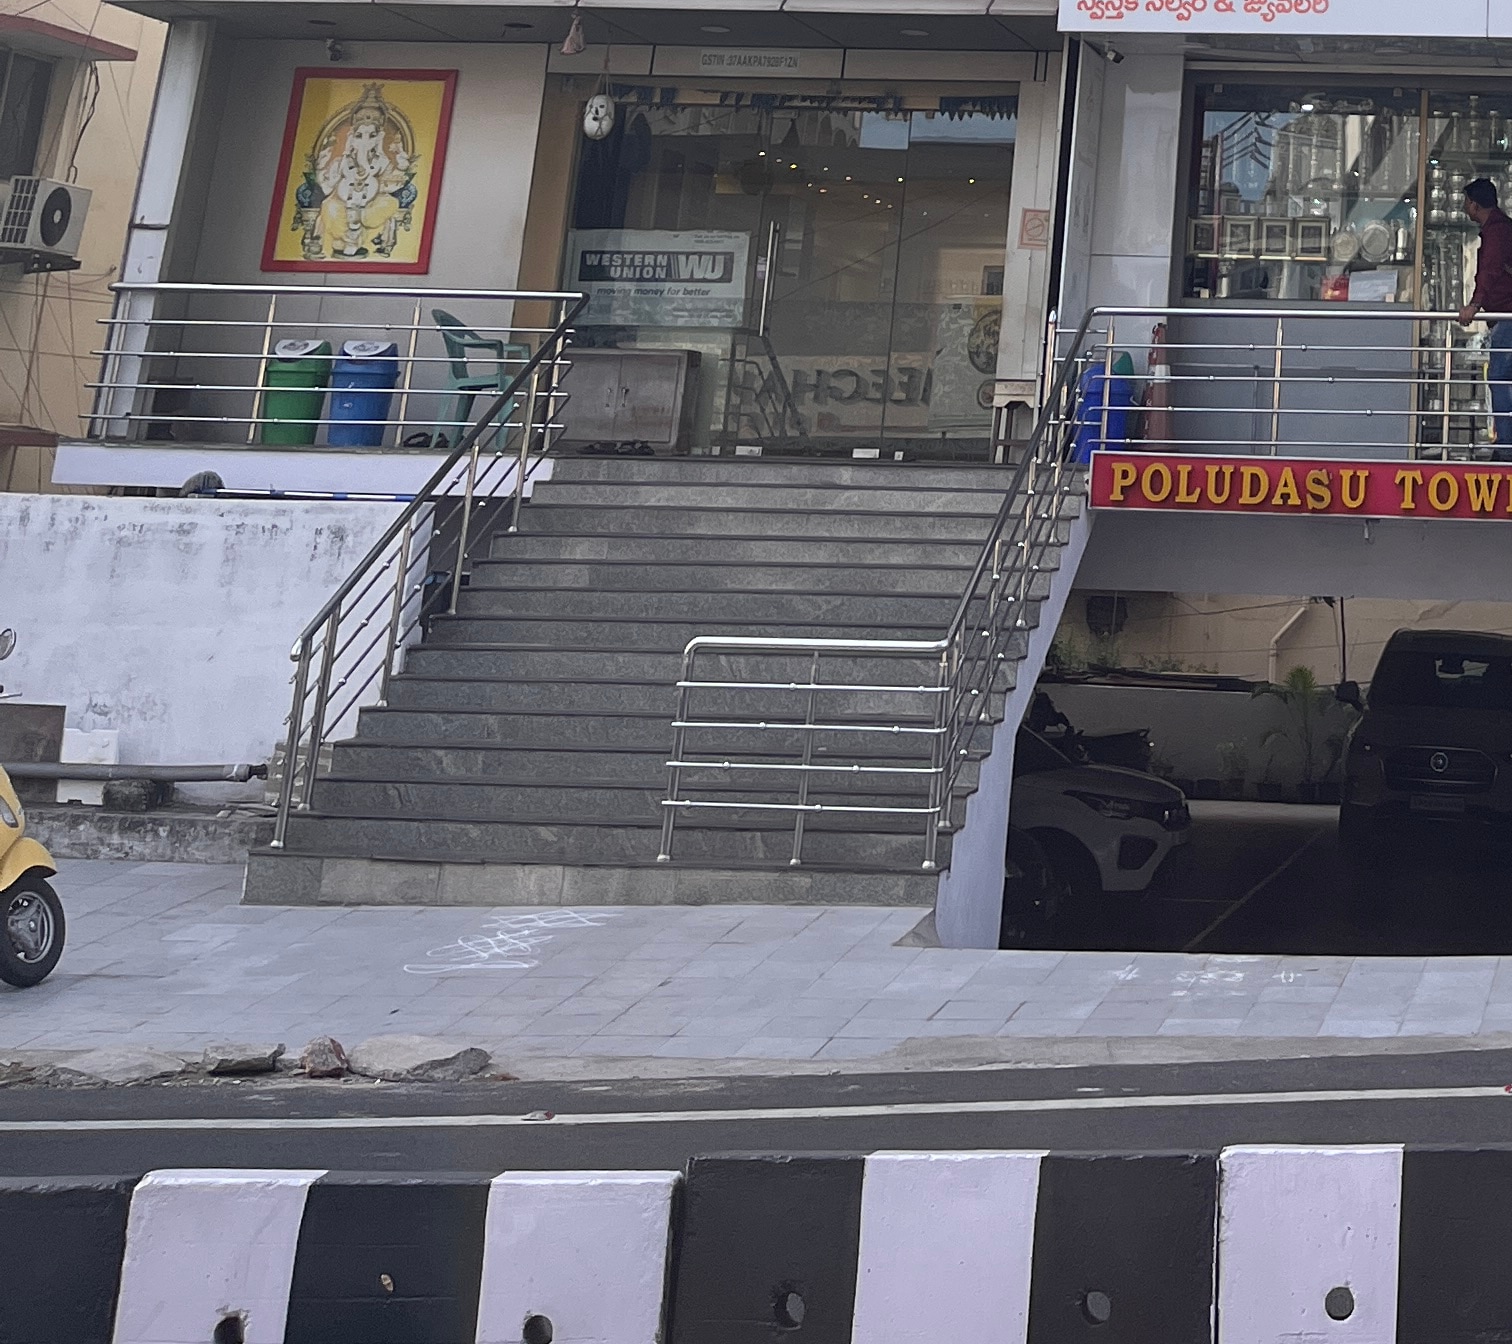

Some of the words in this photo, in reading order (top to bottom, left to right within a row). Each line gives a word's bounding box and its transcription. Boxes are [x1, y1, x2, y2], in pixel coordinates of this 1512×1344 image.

[585, 254, 668, 266] WESTERN
[677, 254, 725, 280] WU
[609, 266, 667, 279] UNION
[597, 288, 631, 297] moving
[634, 288, 665, 298] money
[667, 287, 680, 296] for
[682, 287, 711, 296] better
[1109, 463, 1370, 509] POLUDASU
